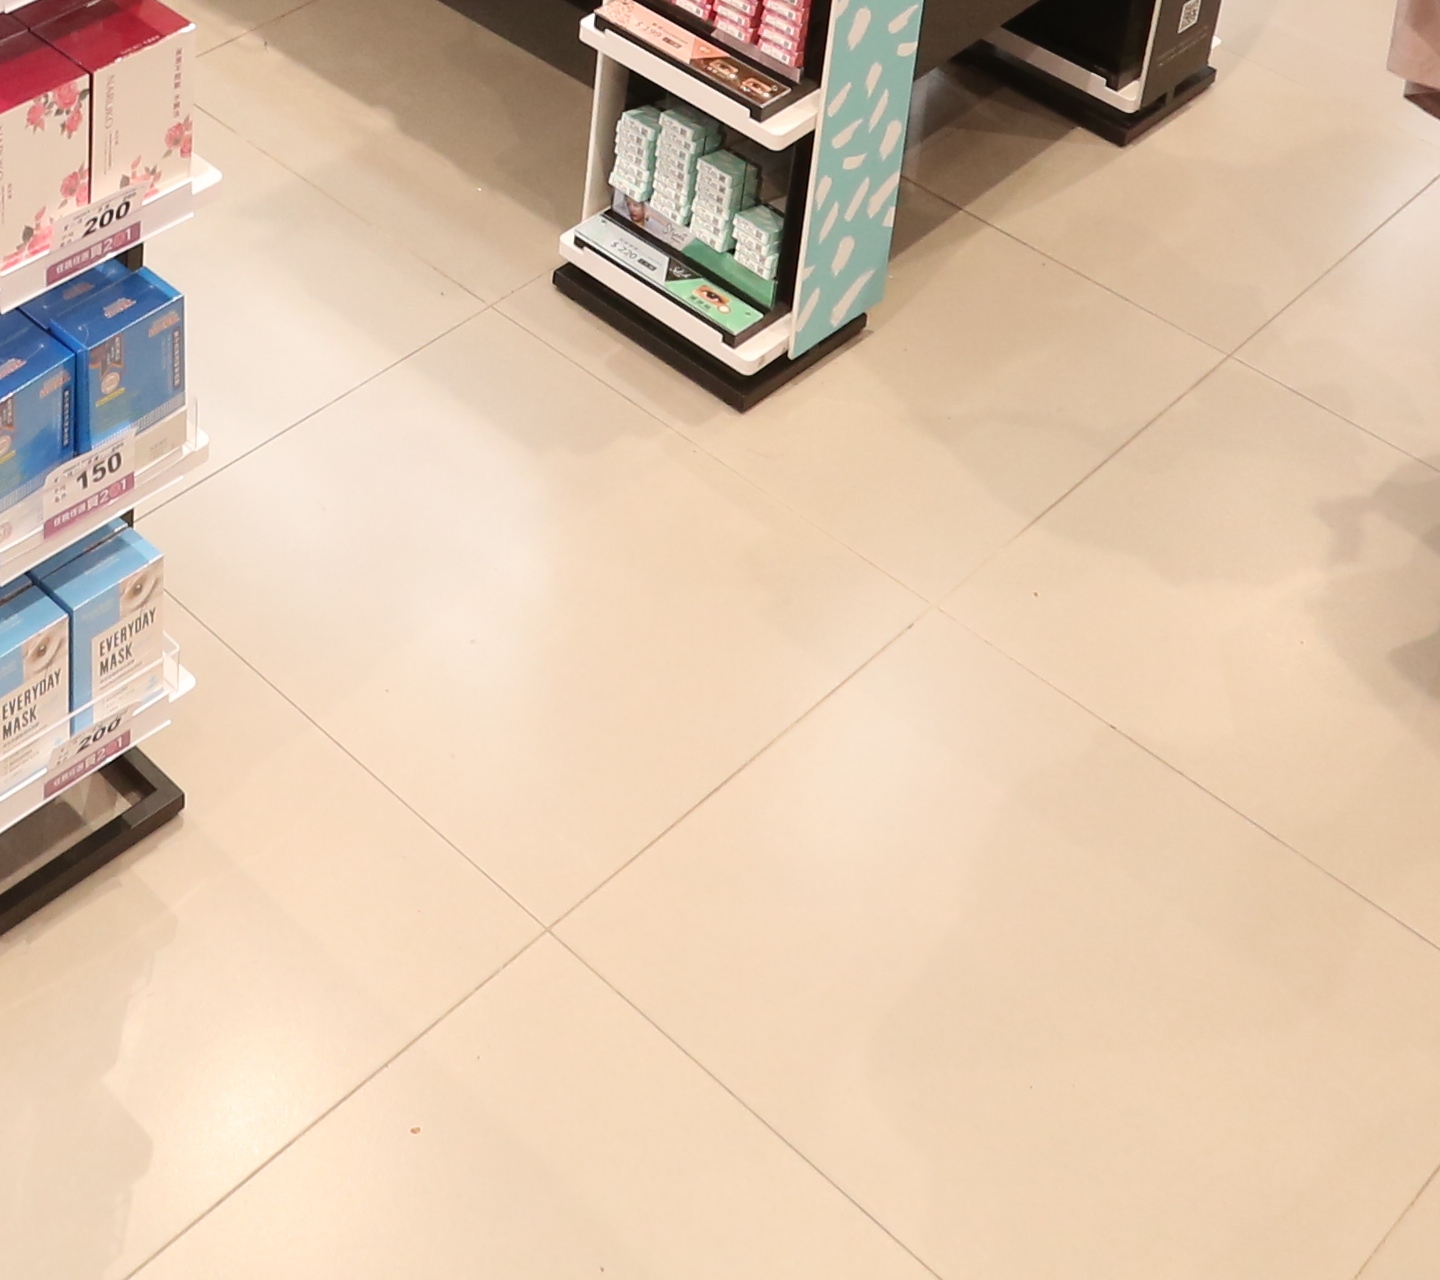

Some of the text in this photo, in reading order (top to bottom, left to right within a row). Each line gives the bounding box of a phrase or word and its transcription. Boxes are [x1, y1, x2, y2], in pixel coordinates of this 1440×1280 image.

[103, 71, 116, 131] NARUKO
[83, 199, 132, 238] 200
[75, 453, 124, 490] 150
[98, 606, 158, 660] EVERYDAY
[98, 642, 135, 681] MASK
[0, 666, 63, 723] EVERYDAY
[0, 705, 41, 744] MASK
[75, 716, 122, 752] 200
